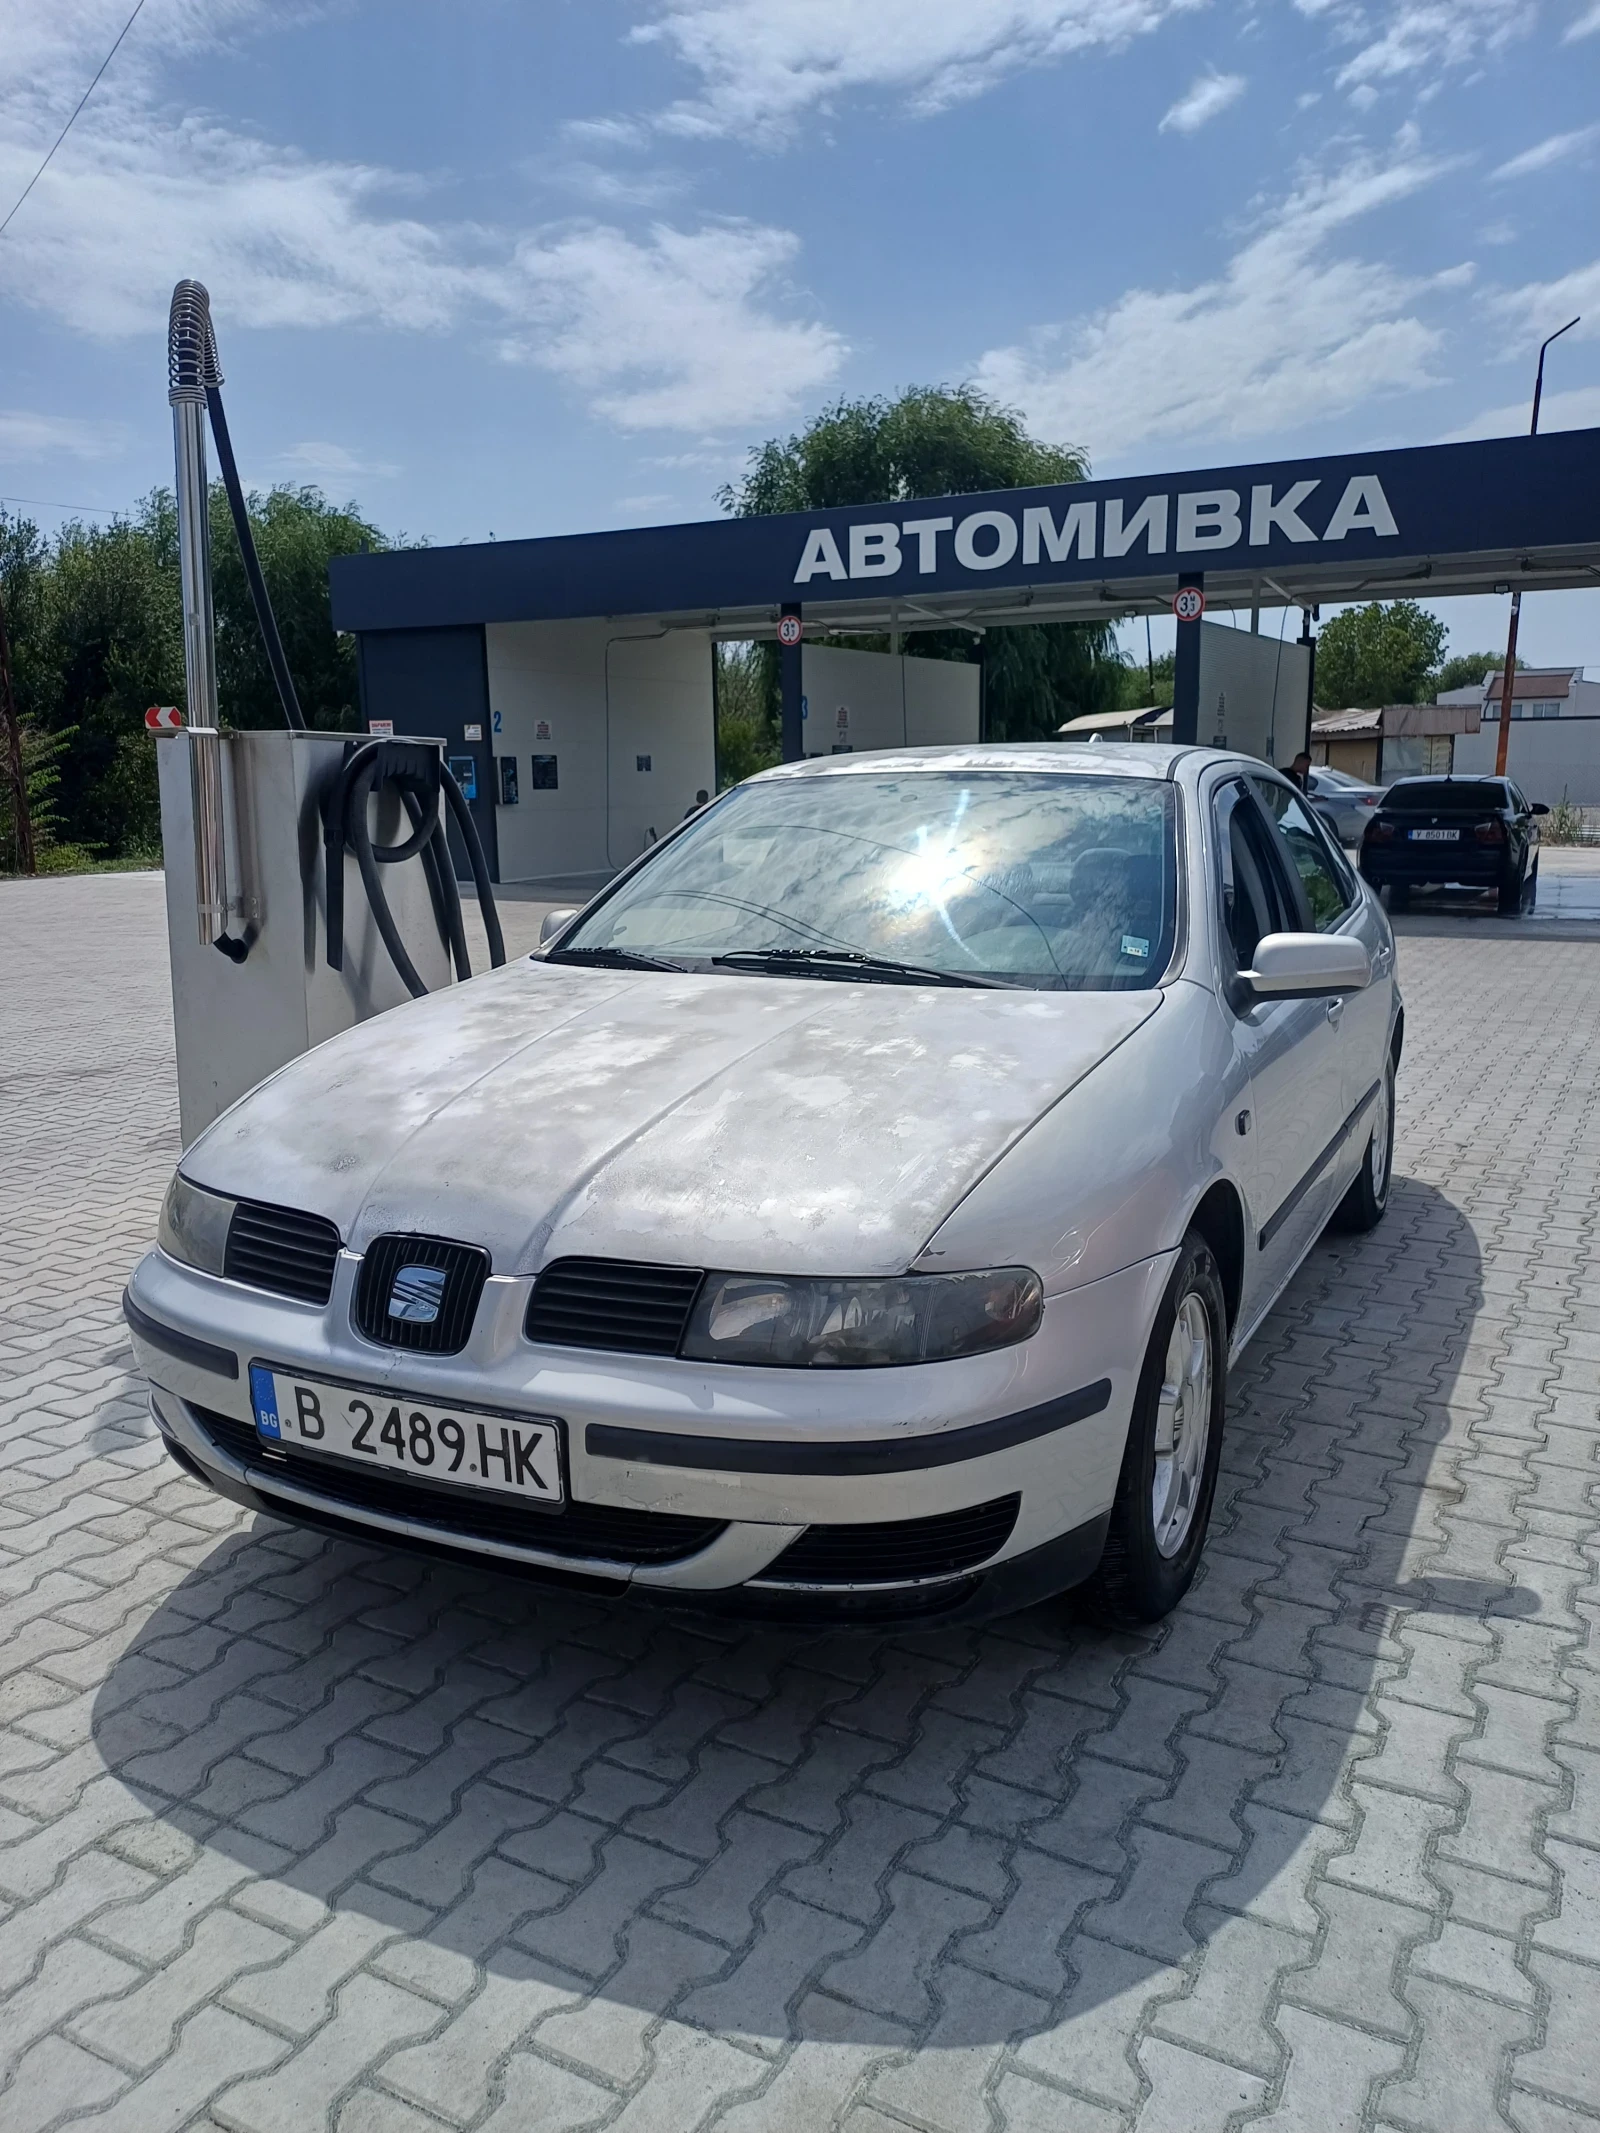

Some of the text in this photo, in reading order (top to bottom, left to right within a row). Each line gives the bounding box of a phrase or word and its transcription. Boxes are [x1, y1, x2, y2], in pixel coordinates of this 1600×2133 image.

[793, 474, 1400, 584] АВТОМИВКА
[1180, 597, 1188, 612] 3
[783, 623, 790, 637] 3
[493, 711, 503, 733] 2
[260, 1410, 279, 1429] BG
[294, 1385, 549, 1490] B 2489 HK
